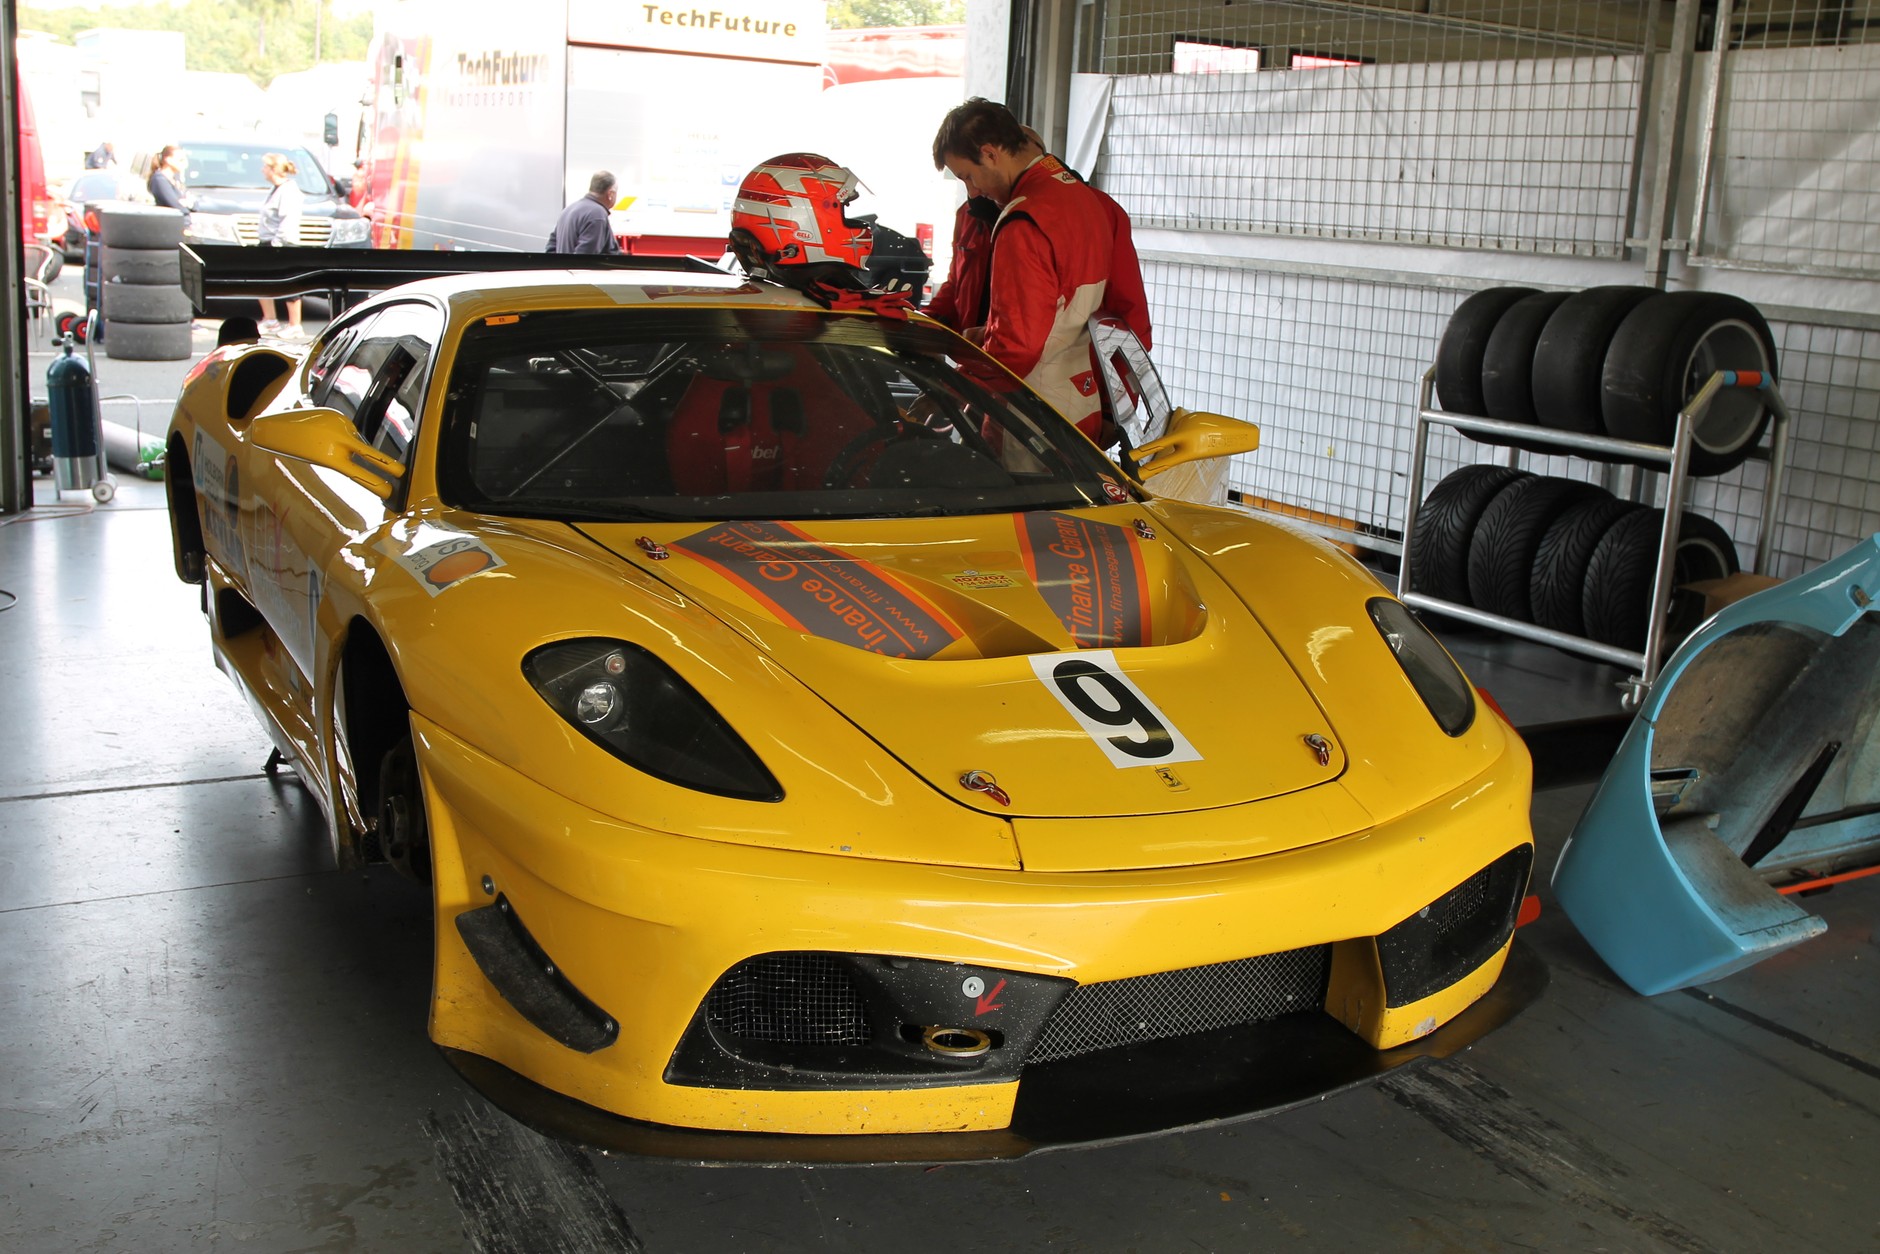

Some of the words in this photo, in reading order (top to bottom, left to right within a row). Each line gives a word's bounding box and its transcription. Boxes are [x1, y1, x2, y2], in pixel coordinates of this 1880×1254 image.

[642, 4, 797, 37] TechFuture
[457, 50, 549, 86] TechFuture
[449, 91, 534, 107] MOTORSPORT
[796, 231, 812, 239] BELL
[707, 530, 799, 582] Garant
[1048, 516, 1086, 560] Garant
[800, 577, 908, 659] inance
[1053, 659, 1175, 759] 9
